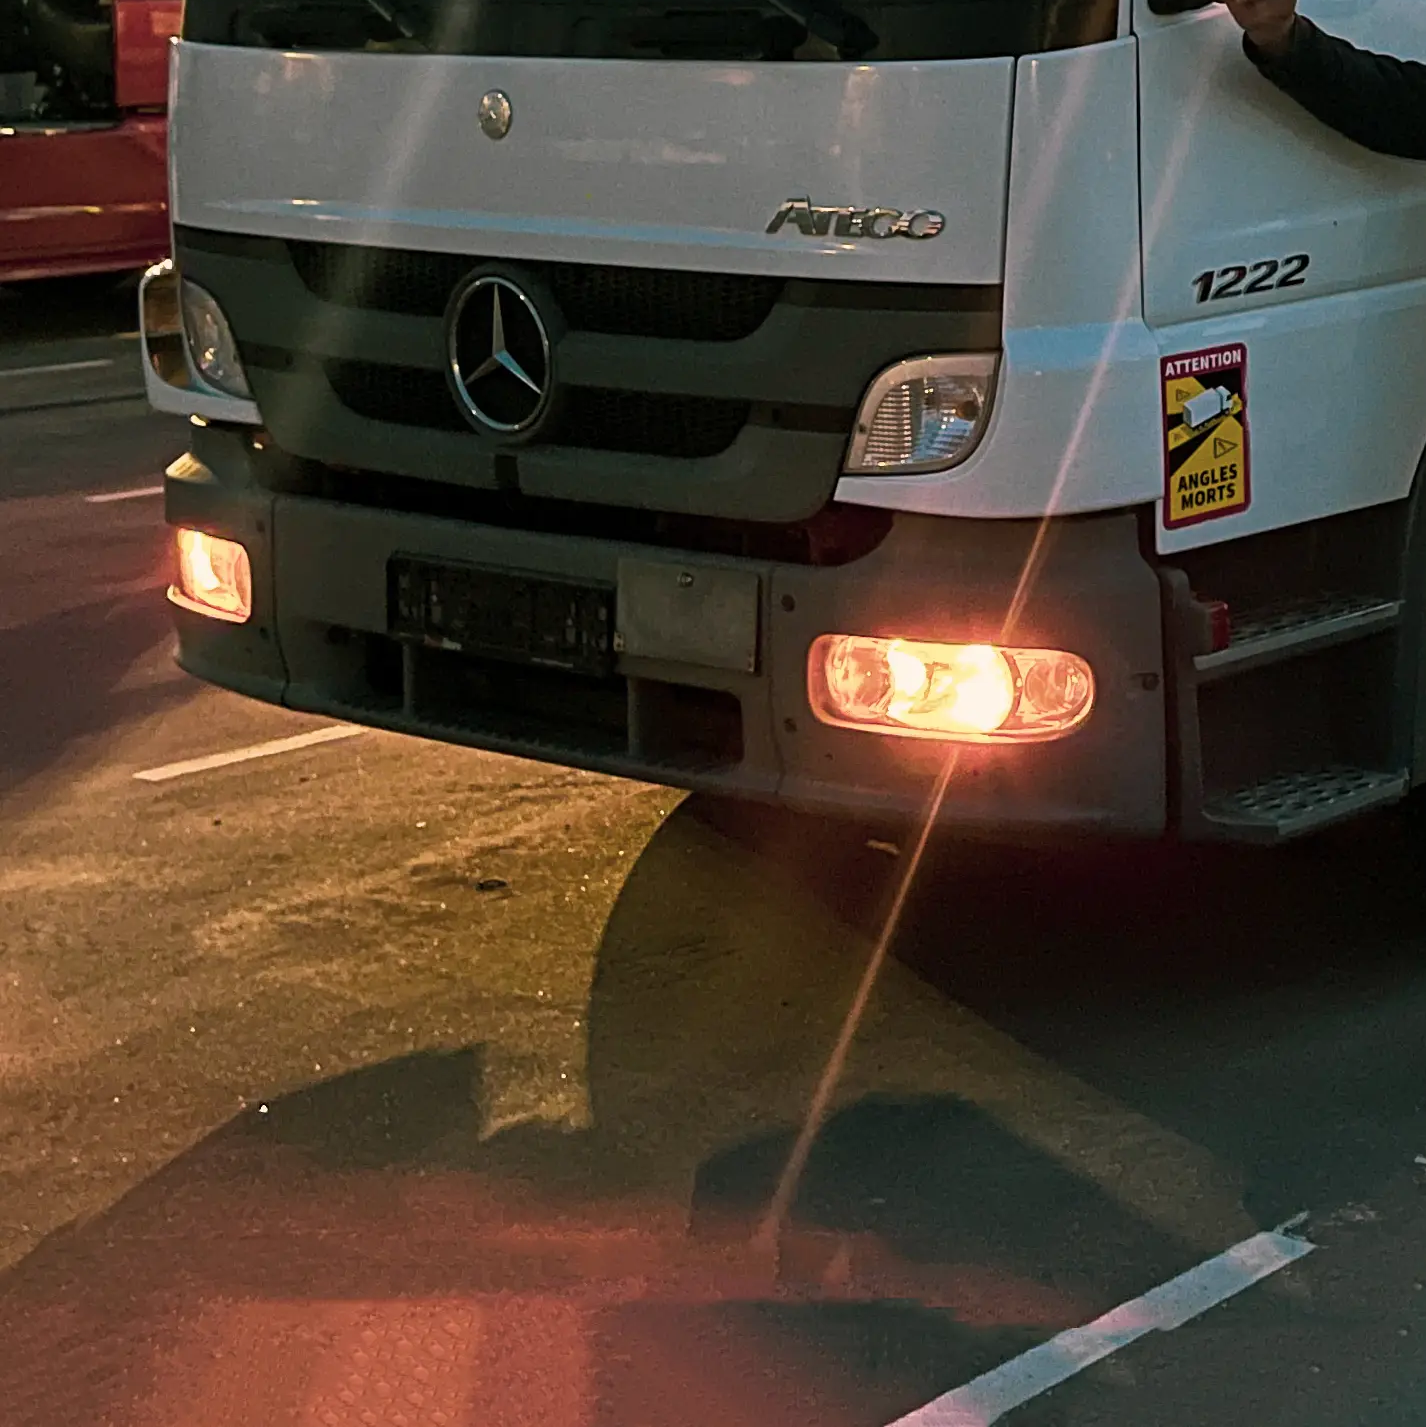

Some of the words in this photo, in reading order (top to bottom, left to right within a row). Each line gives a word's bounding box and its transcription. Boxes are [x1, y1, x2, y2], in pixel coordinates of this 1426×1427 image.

[1191, 254, 1310, 304] 1222
[1165, 349, 1242, 376] ATTENTION
[1177, 463, 1238, 493] ANGLES
[1181, 483, 1236, 511] MORTS
